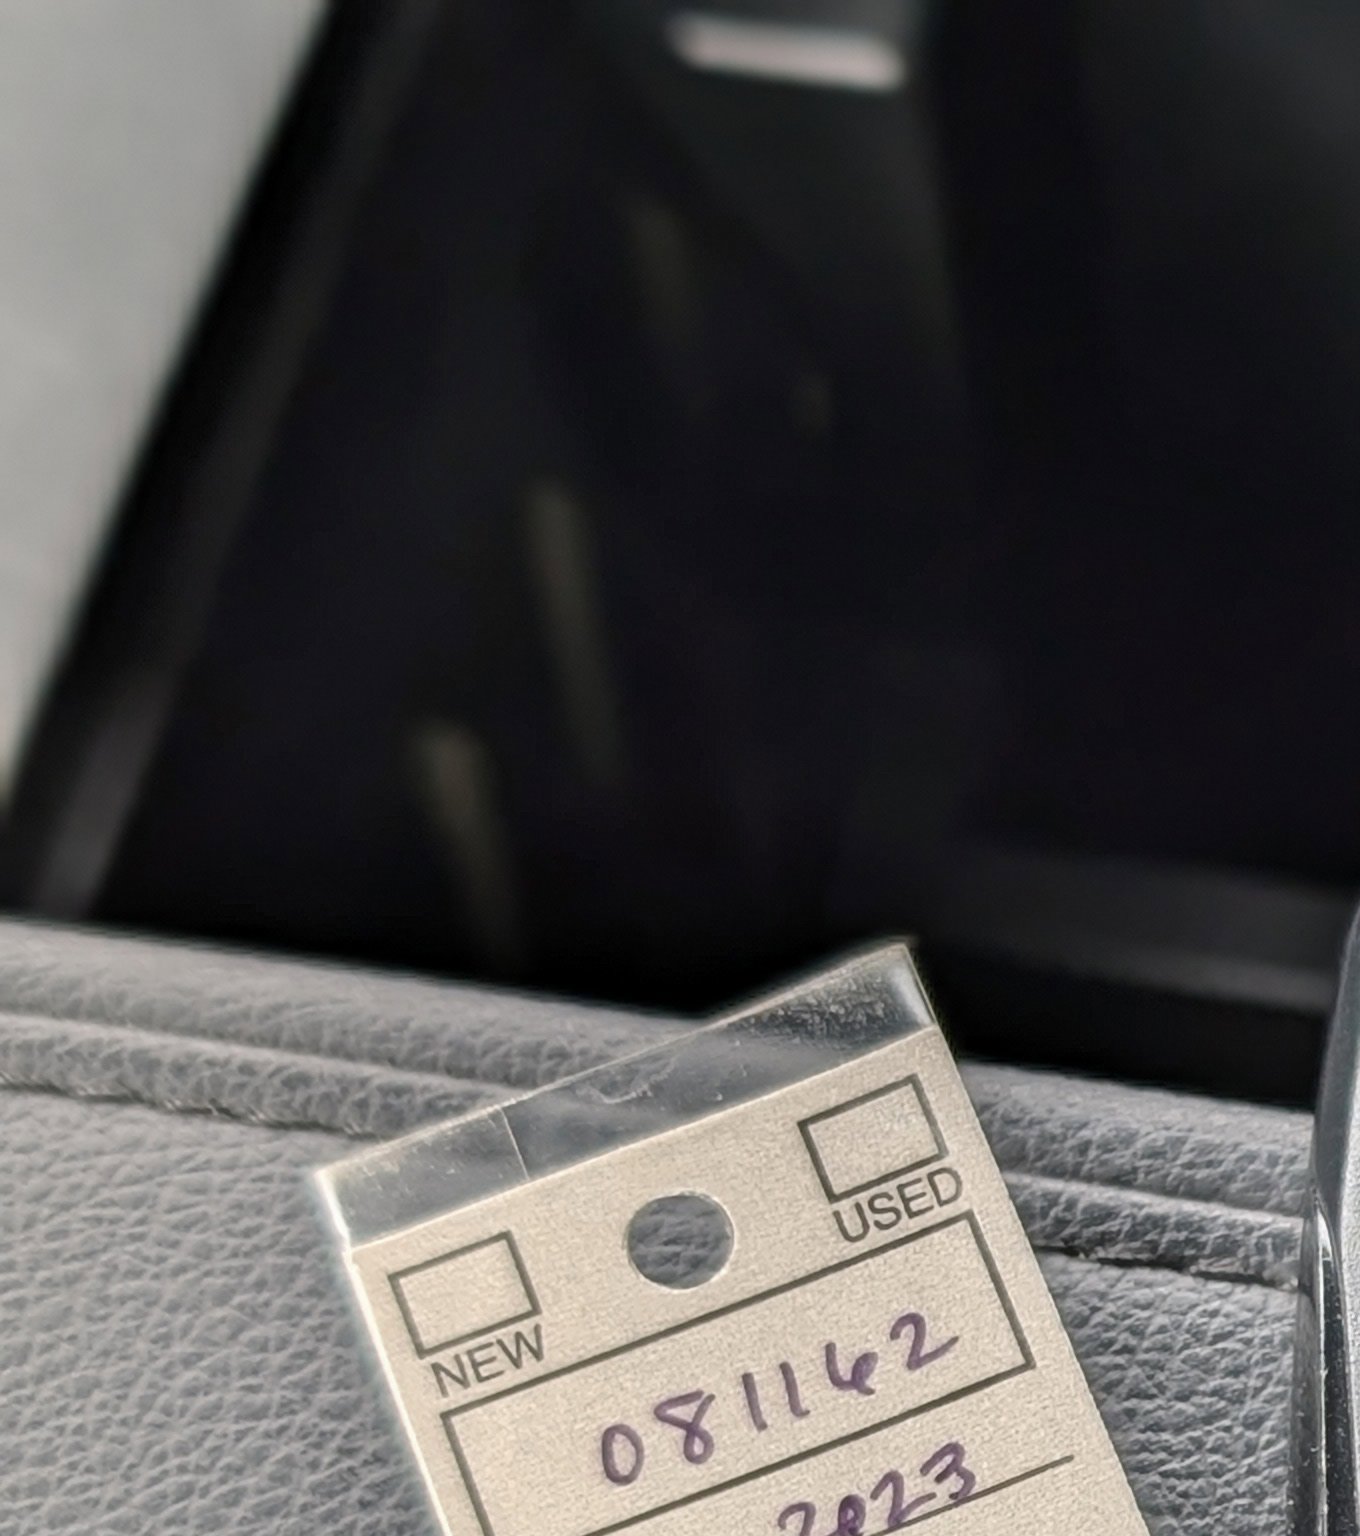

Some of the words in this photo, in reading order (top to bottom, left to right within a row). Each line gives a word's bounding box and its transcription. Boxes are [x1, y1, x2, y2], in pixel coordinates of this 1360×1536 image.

[832, 1166, 964, 1244] USED
[430, 1324, 546, 1398] NEW
[601, 1312, 959, 1486] 081162
